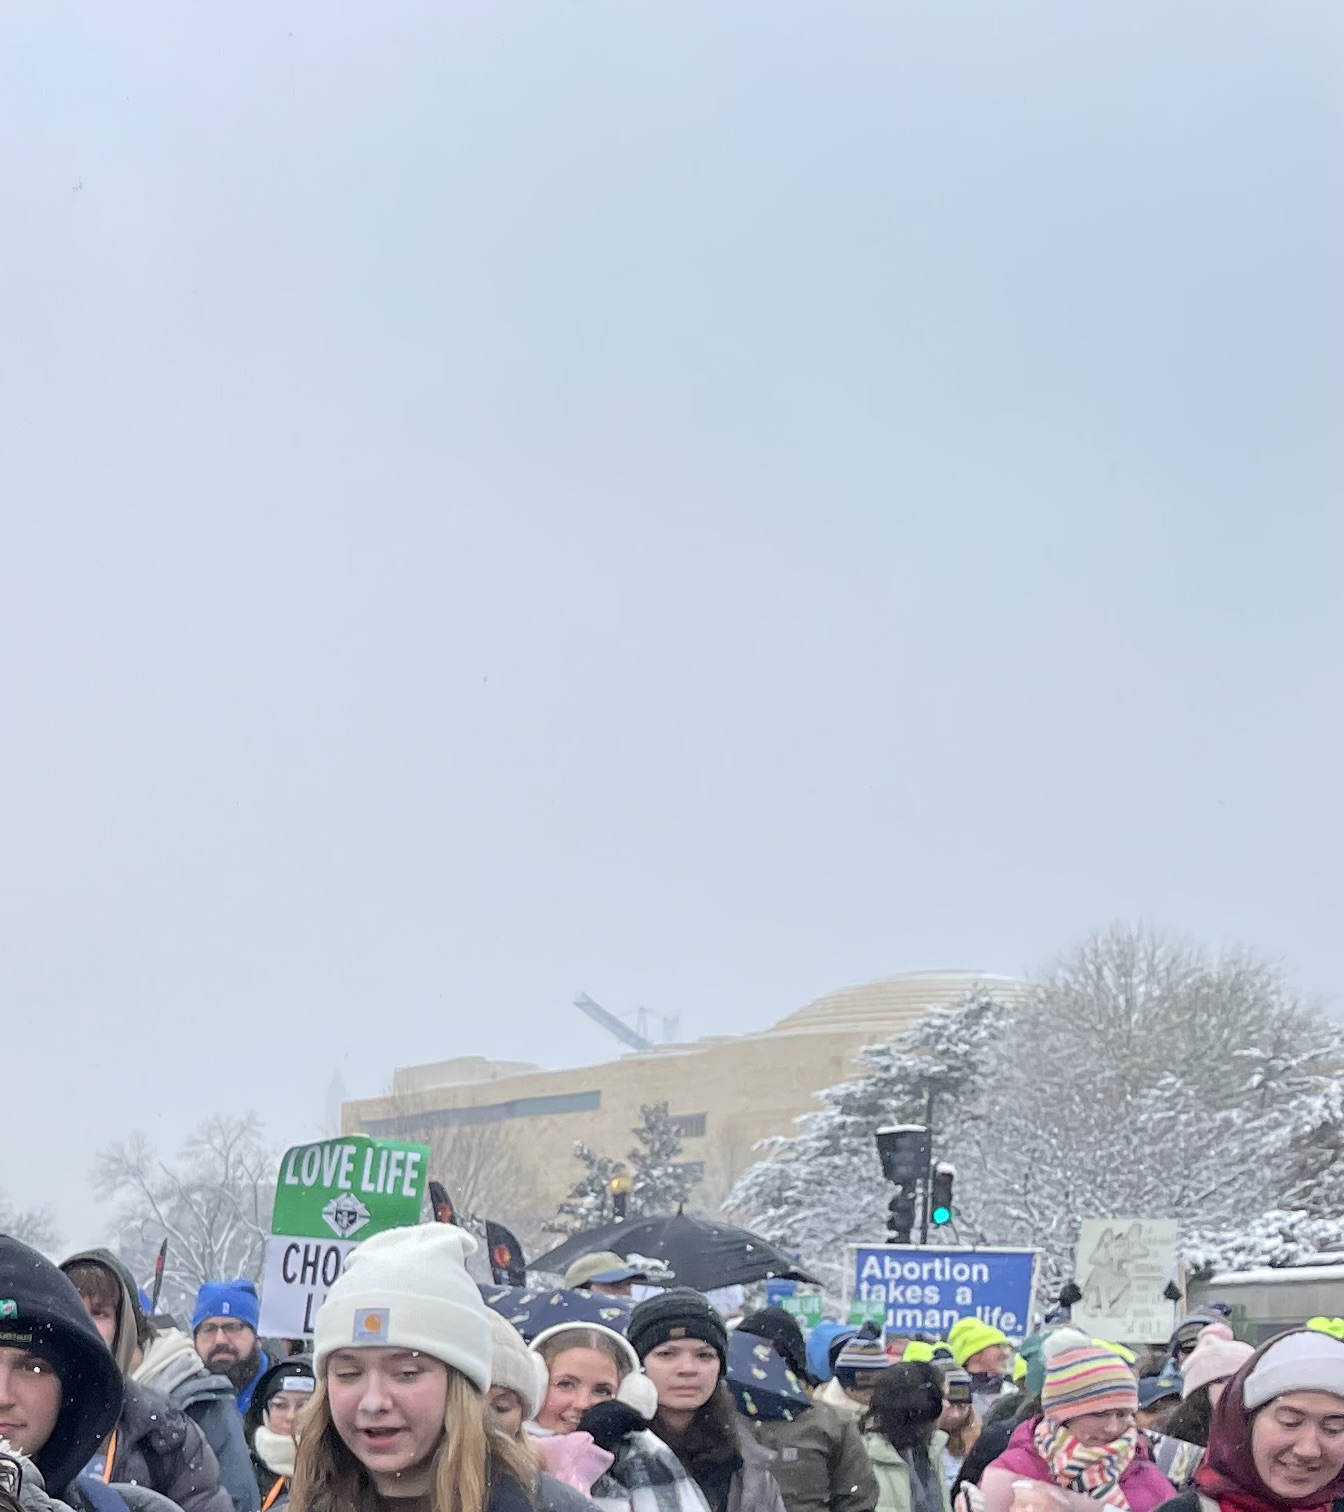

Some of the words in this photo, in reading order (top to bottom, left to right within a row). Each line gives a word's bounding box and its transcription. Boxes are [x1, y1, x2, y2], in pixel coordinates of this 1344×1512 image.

[285, 1144, 357, 1190] LOVE
[362, 1147, 421, 1198] LIFE
[860, 1255, 990, 1283] Abortion
[859, 1279, 941, 1305] takes
[955, 1285, 973, 1306] a
